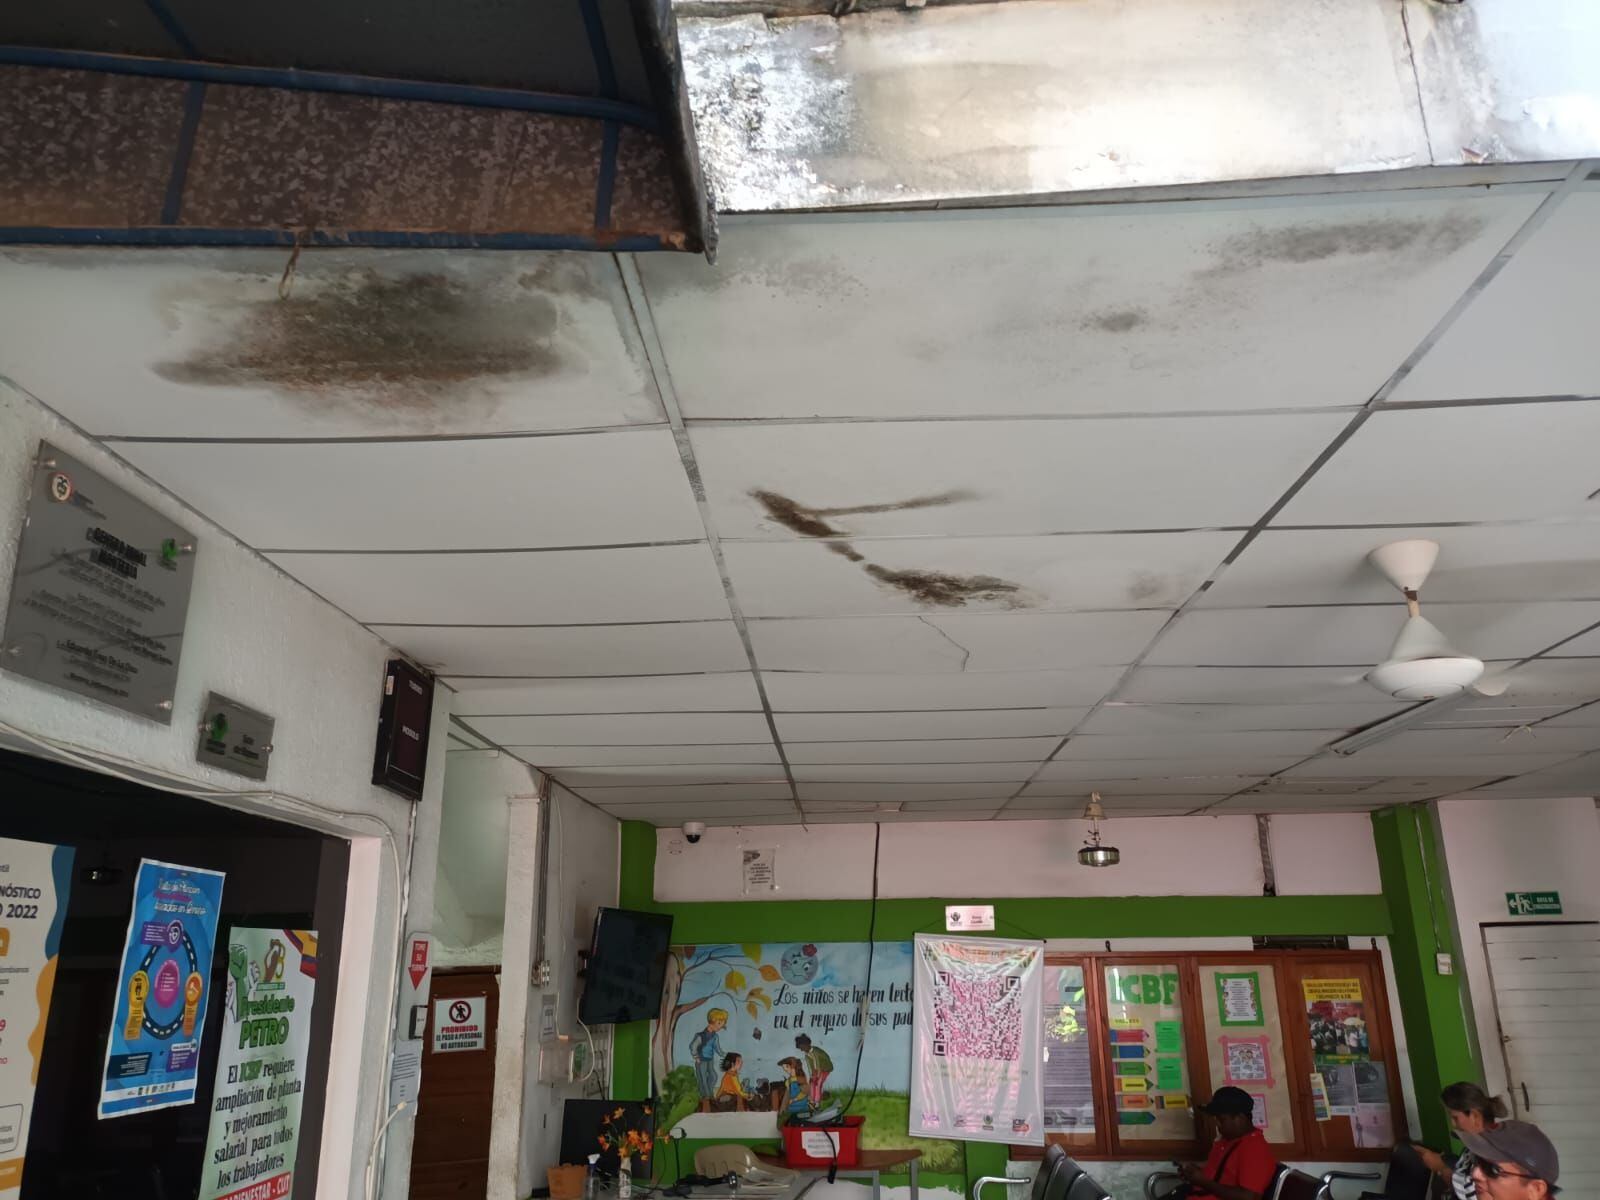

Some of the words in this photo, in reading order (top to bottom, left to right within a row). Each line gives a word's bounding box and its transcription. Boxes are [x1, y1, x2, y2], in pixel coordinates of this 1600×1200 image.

[6, 903, 38, 919] 2022
[773, 983, 798, 1006] Los
[802, 988, 834, 1005] niños
[838, 991, 849, 1004] se
[852, 984, 884, 1004] haen
[1108, 973, 1178, 1005] ICBF
[239, 993, 295, 1020] Presidente
[238, 1016, 290, 1050] PETRO
[441, 1025, 478, 1033] PROHIBIDO
[774, 1014, 789, 1030] en
[793, 1010, 804, 1028] el
[810, 1013, 848, 1035] regazo
[441, 1033, 454, 1041] PASO
[458, 1032, 482, 1040] PERSONAL
[227, 1065, 238, 1084] El
[262, 1057, 295, 1080] requiere
[215, 1085, 264, 1113] ampliación
[266, 1084, 277, 1100] de
[277, 1079, 302, 1102] planta
[223, 1121, 231, 1141] y
[232, 1106, 288, 1135] mejoramiento
[213, 1138, 247, 1165] salarial
[251, 1133, 272, 1157] para
[273, 1125, 294, 1146] todos
[216, 1170, 231, 1190] los
[233, 1153, 285, 1181] trabajadores
[276, 1174, 290, 1195] CUT
